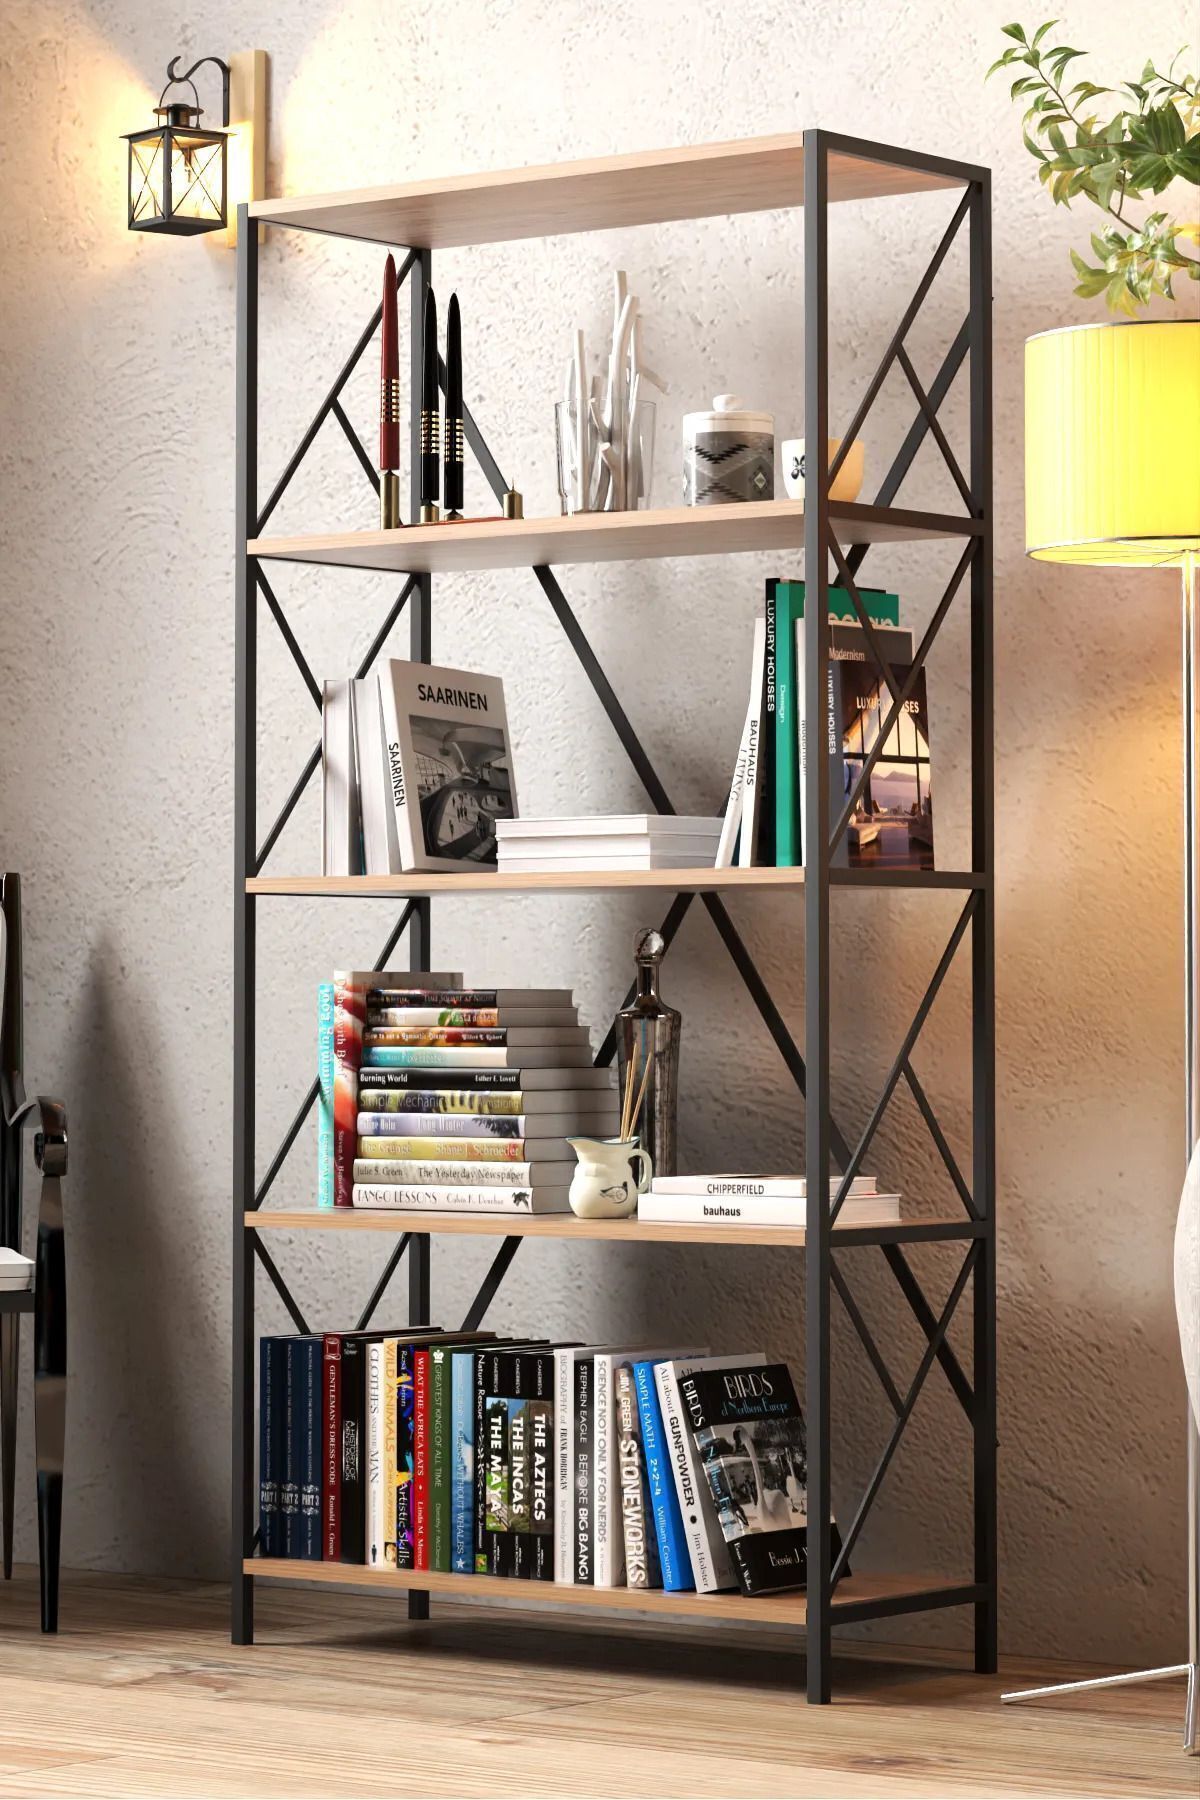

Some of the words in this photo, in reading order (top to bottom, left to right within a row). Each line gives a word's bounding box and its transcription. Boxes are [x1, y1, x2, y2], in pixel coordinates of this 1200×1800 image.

[766, 600, 775, 653] LUXURY
[829, 647, 865, 661] Modernism
[417, 683, 489, 712] SAARINEN
[766, 656, 775, 713] HOUSES
[856, 695, 887, 711] LUXUR
[829, 713, 837, 755] HOUSES
[746, 719, 758, 786] BAUHAUS
[388, 742, 405, 807] SAARINEN
[360, 1073, 386, 1084] Burning
[387, 1073, 408, 1083] World
[475, 1074, 492, 1082] Esther
[474, 1143, 520, 1156] Schroeder
[357, 1166, 373, 1176] Julie
[382, 1167, 404, 1177] Green
[417, 1167, 433, 1178] The
[435, 1167, 475, 1180] Yesterday
[476, 1168, 525, 1183] Newspaper
[357, 1189, 391, 1203] TANGO
[394, 1190, 438, 1204] LESSONS
[706, 1183, 765, 1195] CHIPPERFIELD
[703, 1205, 741, 1217] bauhaus
[386, 1342, 396, 1379] WILD
[417, 1357, 425, 1386] WHAT
[477, 1354, 485, 1386] Nature
[660, 1367, 669, 1382] All
[370, 1348, 379, 1414] CLOTHES
[434, 1364, 442, 1406] GREATEST
[598, 1360, 606, 1406] SCIENCE
[619, 1374, 630, 1393] JIM
[637, 1368, 650, 1410] SIMPLE
[723, 1371, 774, 1400] BIRDS
[417, 1389, 425, 1410] THE
[477, 1388, 485, 1420] Rescue
[620, 1397, 633, 1432] GREEN
[664, 1384, 675, 1414] about
[683, 1379, 706, 1428] BIRDS
[350, 1420, 356, 1428] A
[386, 1383, 396, 1453] ANIMALS
[417, 1411, 425, 1449] AFRICA
[434, 1408, 442, 1434] KINGS
[490, 1416, 502, 1449] THE
[512, 1417, 524, 1450] THE
[534, 1413, 546, 1447] THE
[598, 1408, 606, 1437] NOT
[643, 1413, 656, 1449] MATH
[434, 1435, 442, 1447] OF
[434, 1449, 442, 1465] ALL
[598, 1438, 606, 1475] ONLY
[350, 1467, 356, 1481] OF
[370, 1450, 379, 1484] MAN
[417, 1451, 425, 1477] EATS
[669, 1416, 695, 1507] GUNPOWDER
[434, 1468, 442, 1488] TIME
[456, 1463, 464, 1509] WITHOUT
[490, 1454, 502, 1513] MAYA
[512, 1456, 524, 1515] INCAS
[534, 1452, 546, 1521] AZTECS
[579, 1453, 588, 1505] BEFORE
[598, 1477, 606, 1504] FOR
[260, 1490, 274, 1503] PART
[281, 1492, 294, 1504] PART
[302, 1493, 315, 1506] PART
[315, 1494, 320, 1506] 3
[398, 1482, 409, 1530] Artistic
[417, 1501, 425, 1524] Linda
[620, 1440, 646, 1583] STONEWORKS
[456, 1512, 464, 1555] WHALES
[579, 1507, 588, 1530] BIG
[598, 1505, 606, 1543] NERDS
[398, 1531, 410, 1565] Skills
[417, 1539, 425, 1567] Mercer
[579, 1533, 588, 1580] BANG!
[657, 1506, 669, 1543] William
[663, 1544, 673, 1585] Counter
[692, 1533, 701, 1551] Jim
[697, 1552, 709, 1588] Holster
